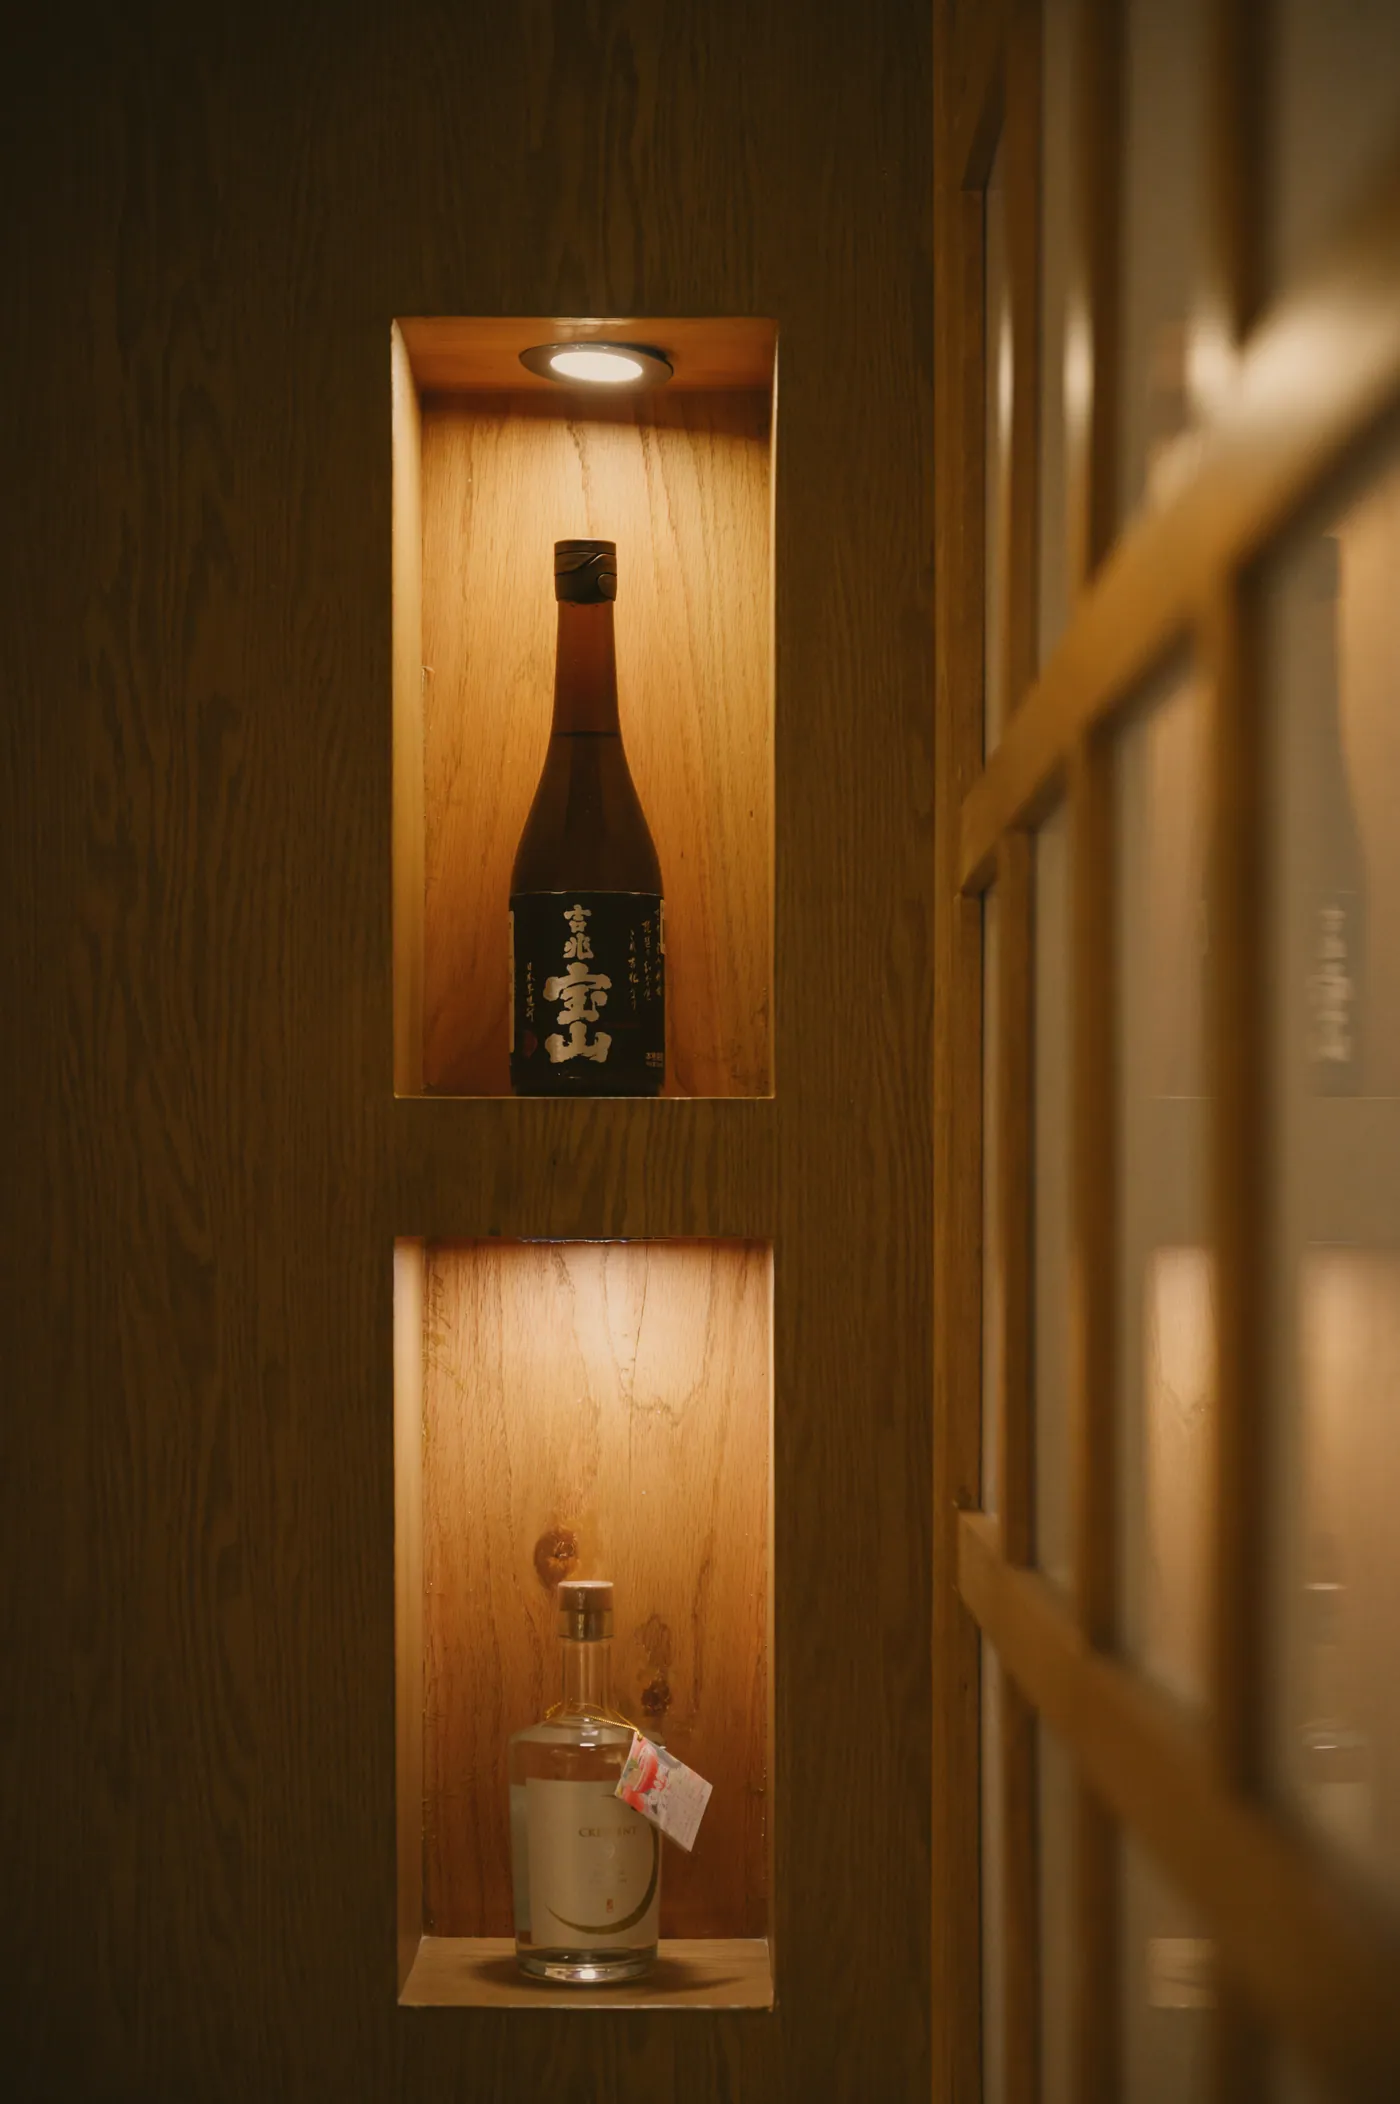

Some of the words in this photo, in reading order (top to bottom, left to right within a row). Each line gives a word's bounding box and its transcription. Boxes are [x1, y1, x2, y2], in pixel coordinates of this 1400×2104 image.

[542, 903, 613, 1064] 吉兆宝山
[578, 1826, 637, 1838] CREENT
